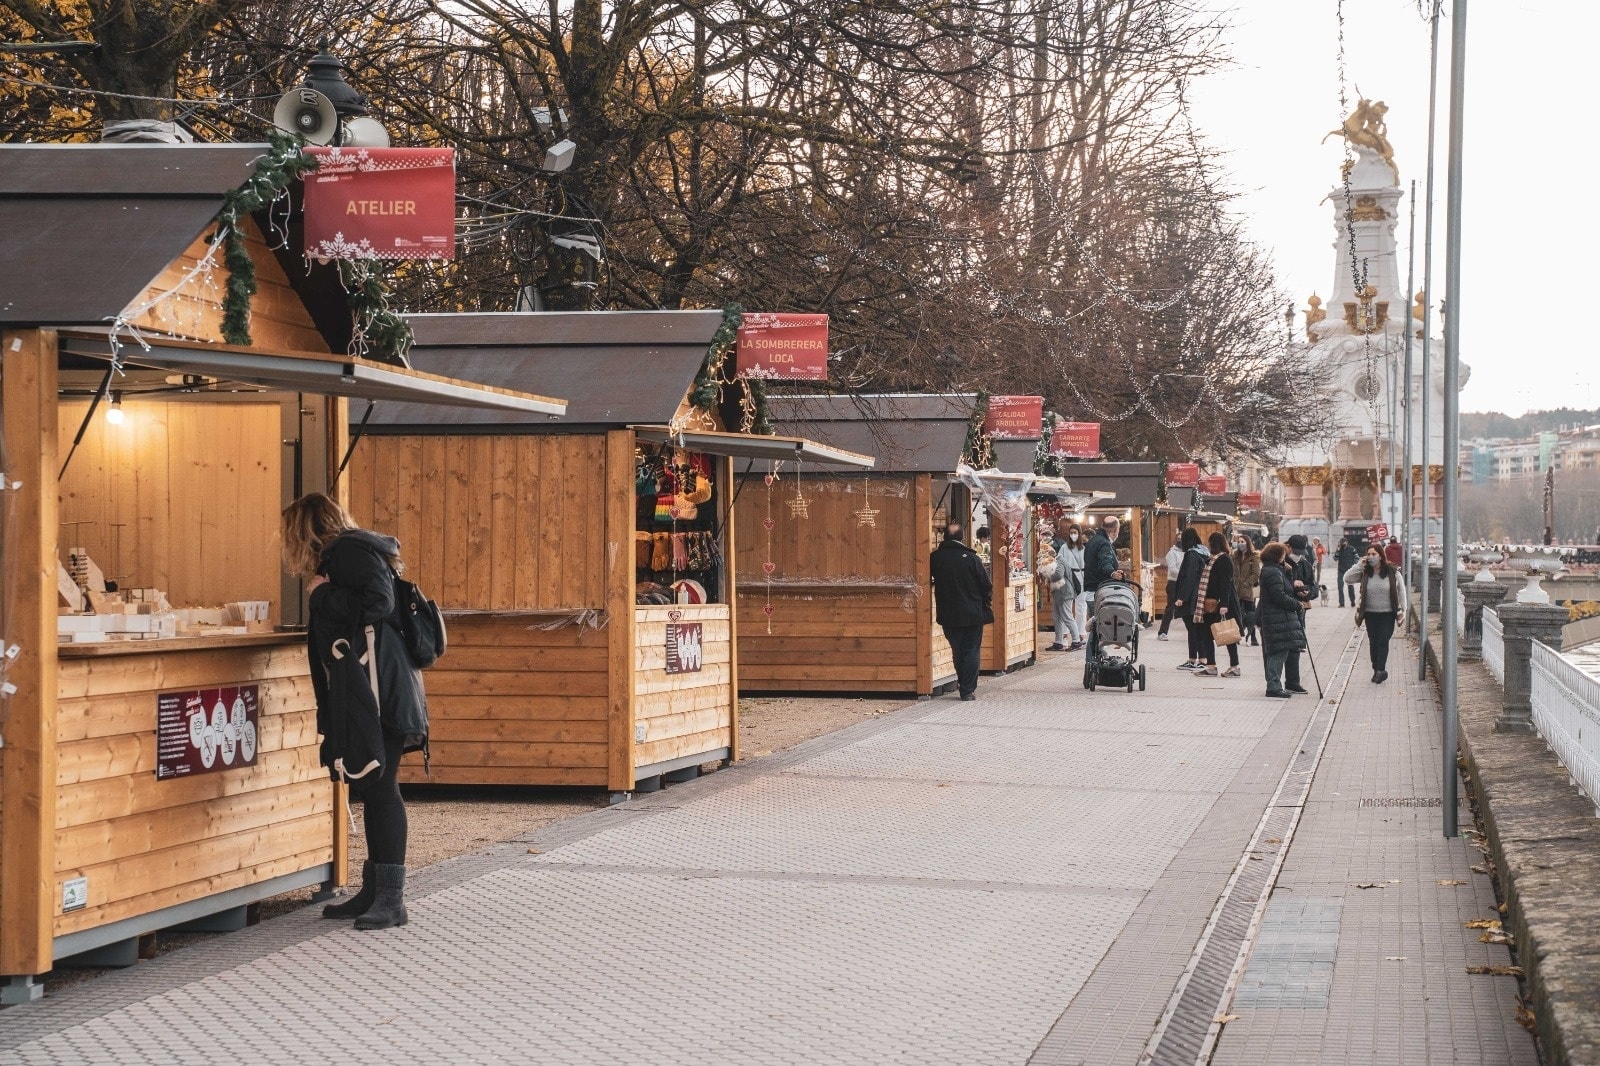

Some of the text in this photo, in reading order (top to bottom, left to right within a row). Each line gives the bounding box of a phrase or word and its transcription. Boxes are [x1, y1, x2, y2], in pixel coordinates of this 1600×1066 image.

[346, 200, 416, 215] ATELIER
[741, 339, 824, 350] LA SOMBRERERA
[769, 353, 795, 363] LOCA
